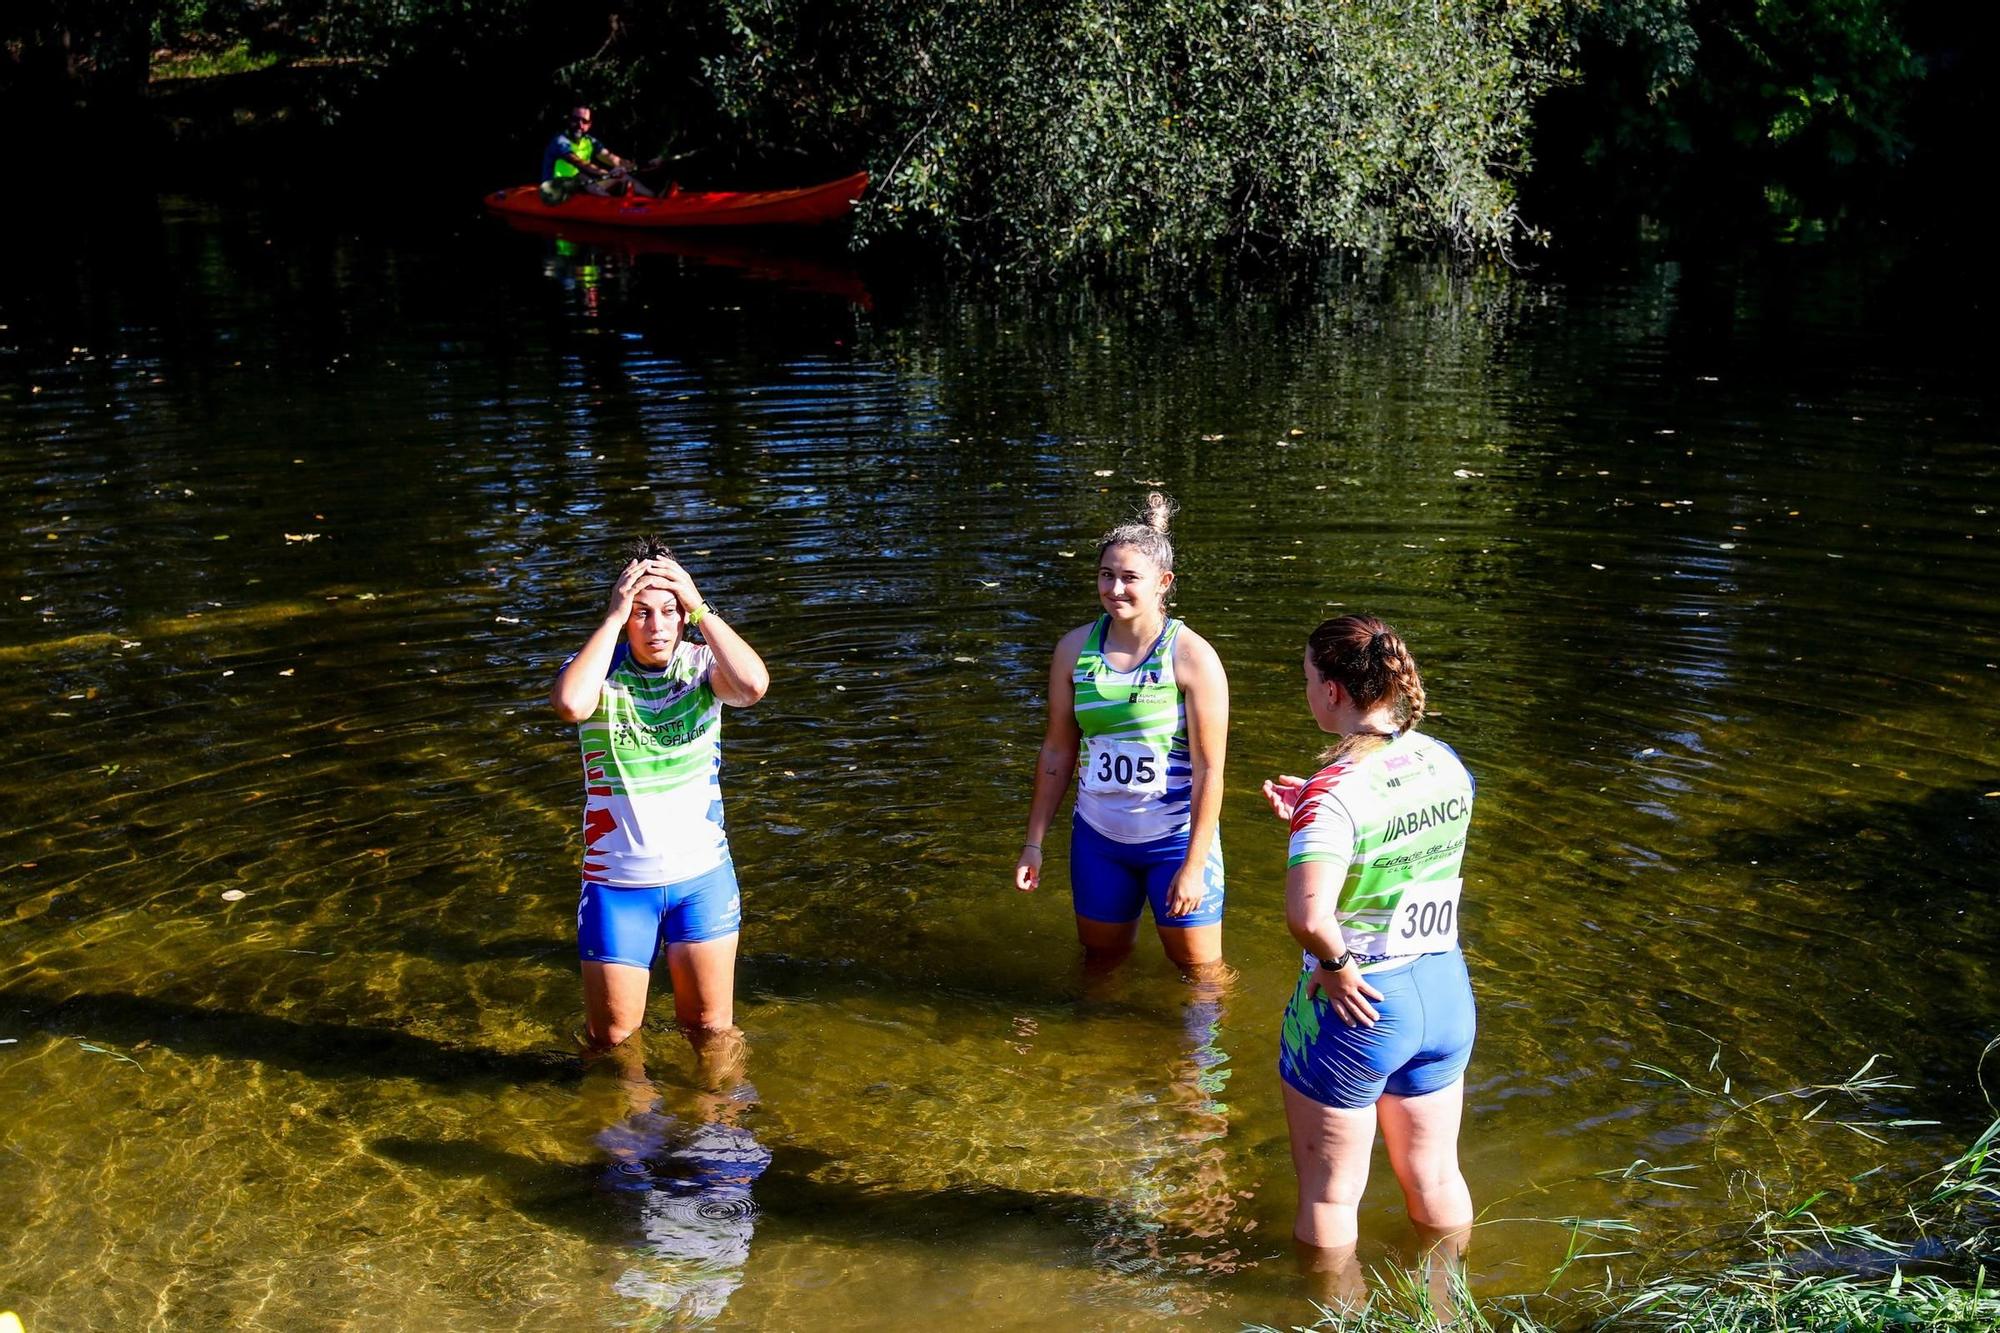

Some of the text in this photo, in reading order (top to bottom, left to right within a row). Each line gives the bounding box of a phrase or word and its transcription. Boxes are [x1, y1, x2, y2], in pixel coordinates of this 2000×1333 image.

[640, 720, 685, 734] XUNTA
[640, 724, 706, 748] DE GALICIA
[1097, 752, 1156, 784] 305
[1392, 795, 1469, 841] ABANCA
[1426, 845, 1443, 855] de
[1400, 900, 1453, 939] 300
